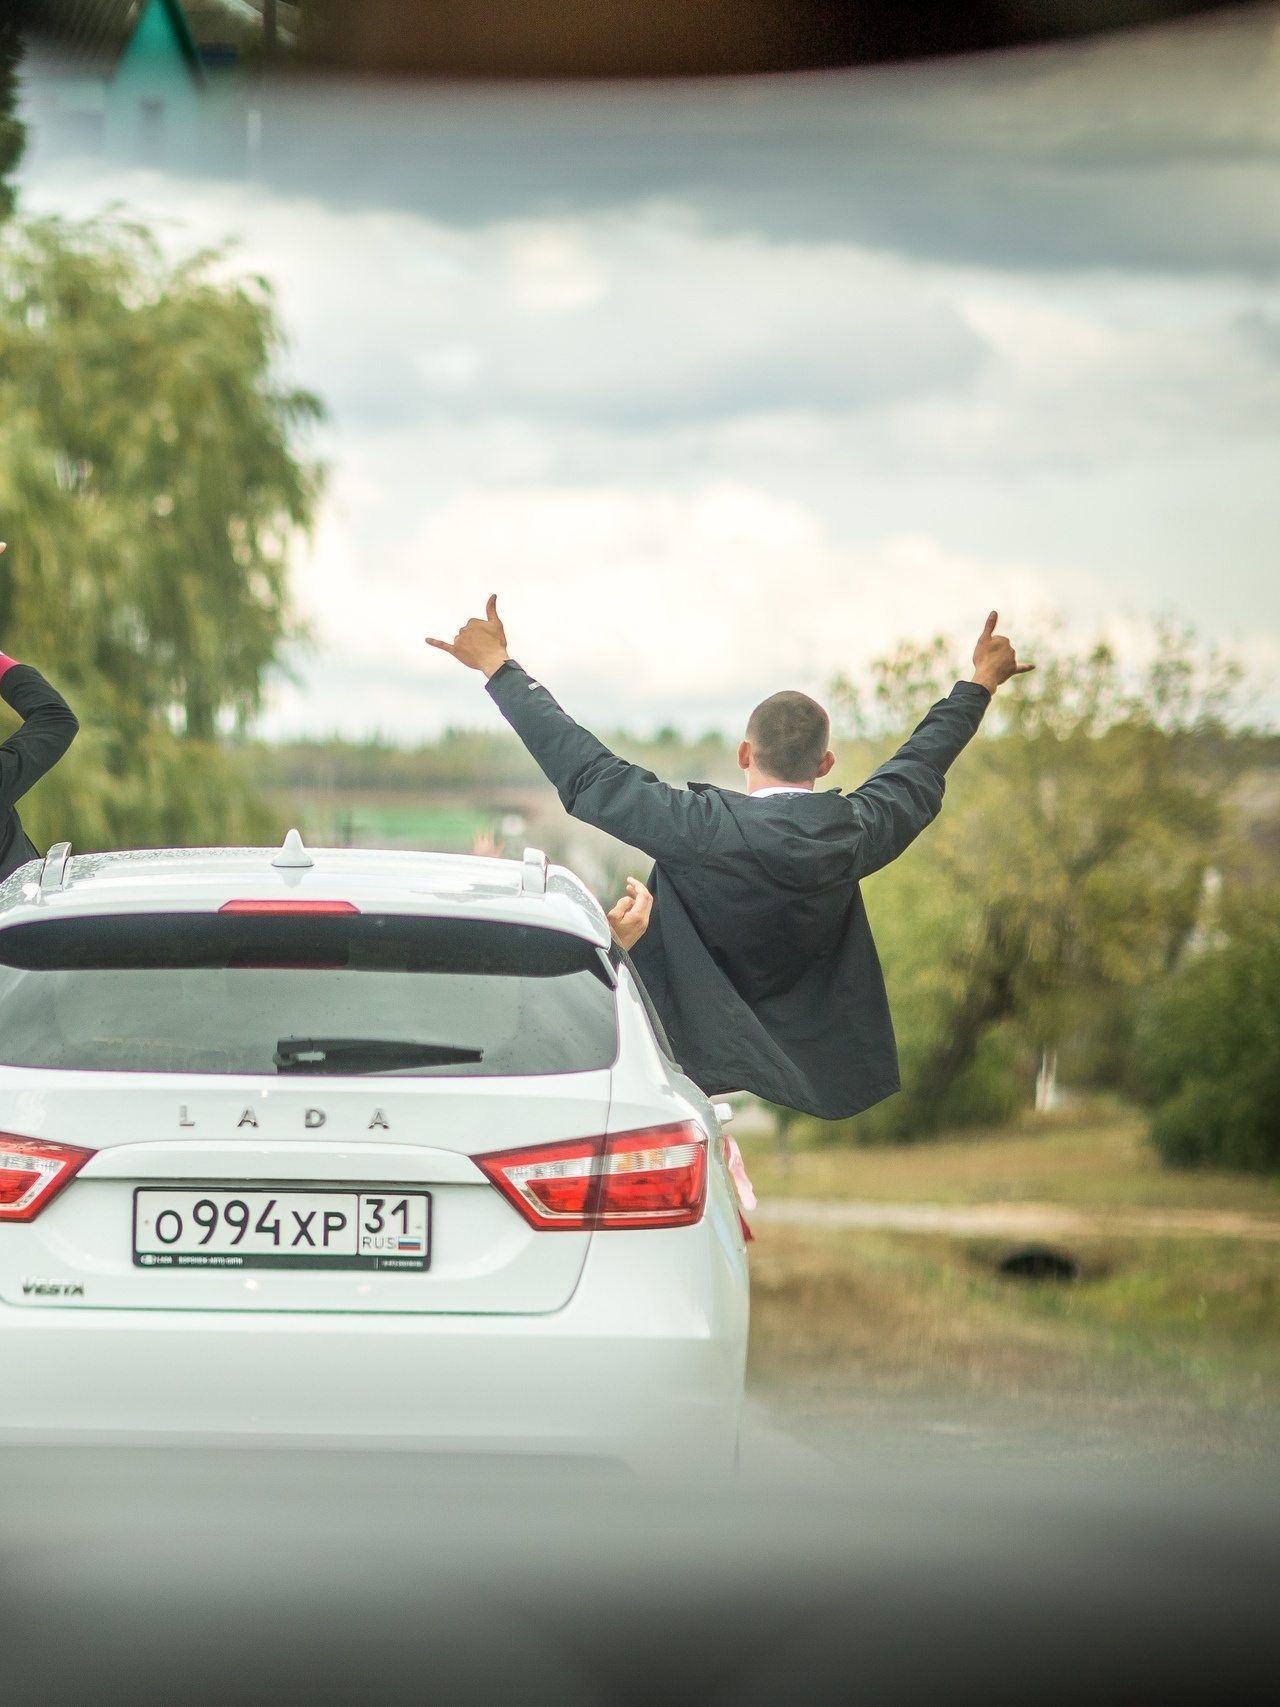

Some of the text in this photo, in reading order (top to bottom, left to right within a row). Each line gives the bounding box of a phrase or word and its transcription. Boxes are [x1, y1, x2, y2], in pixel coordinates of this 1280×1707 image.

[179, 1104, 390, 1130] LADA
[364, 1198, 408, 1235] 31
[362, 1236, 396, 1250] RUS
[21, 1277, 84, 1296] VESTA
